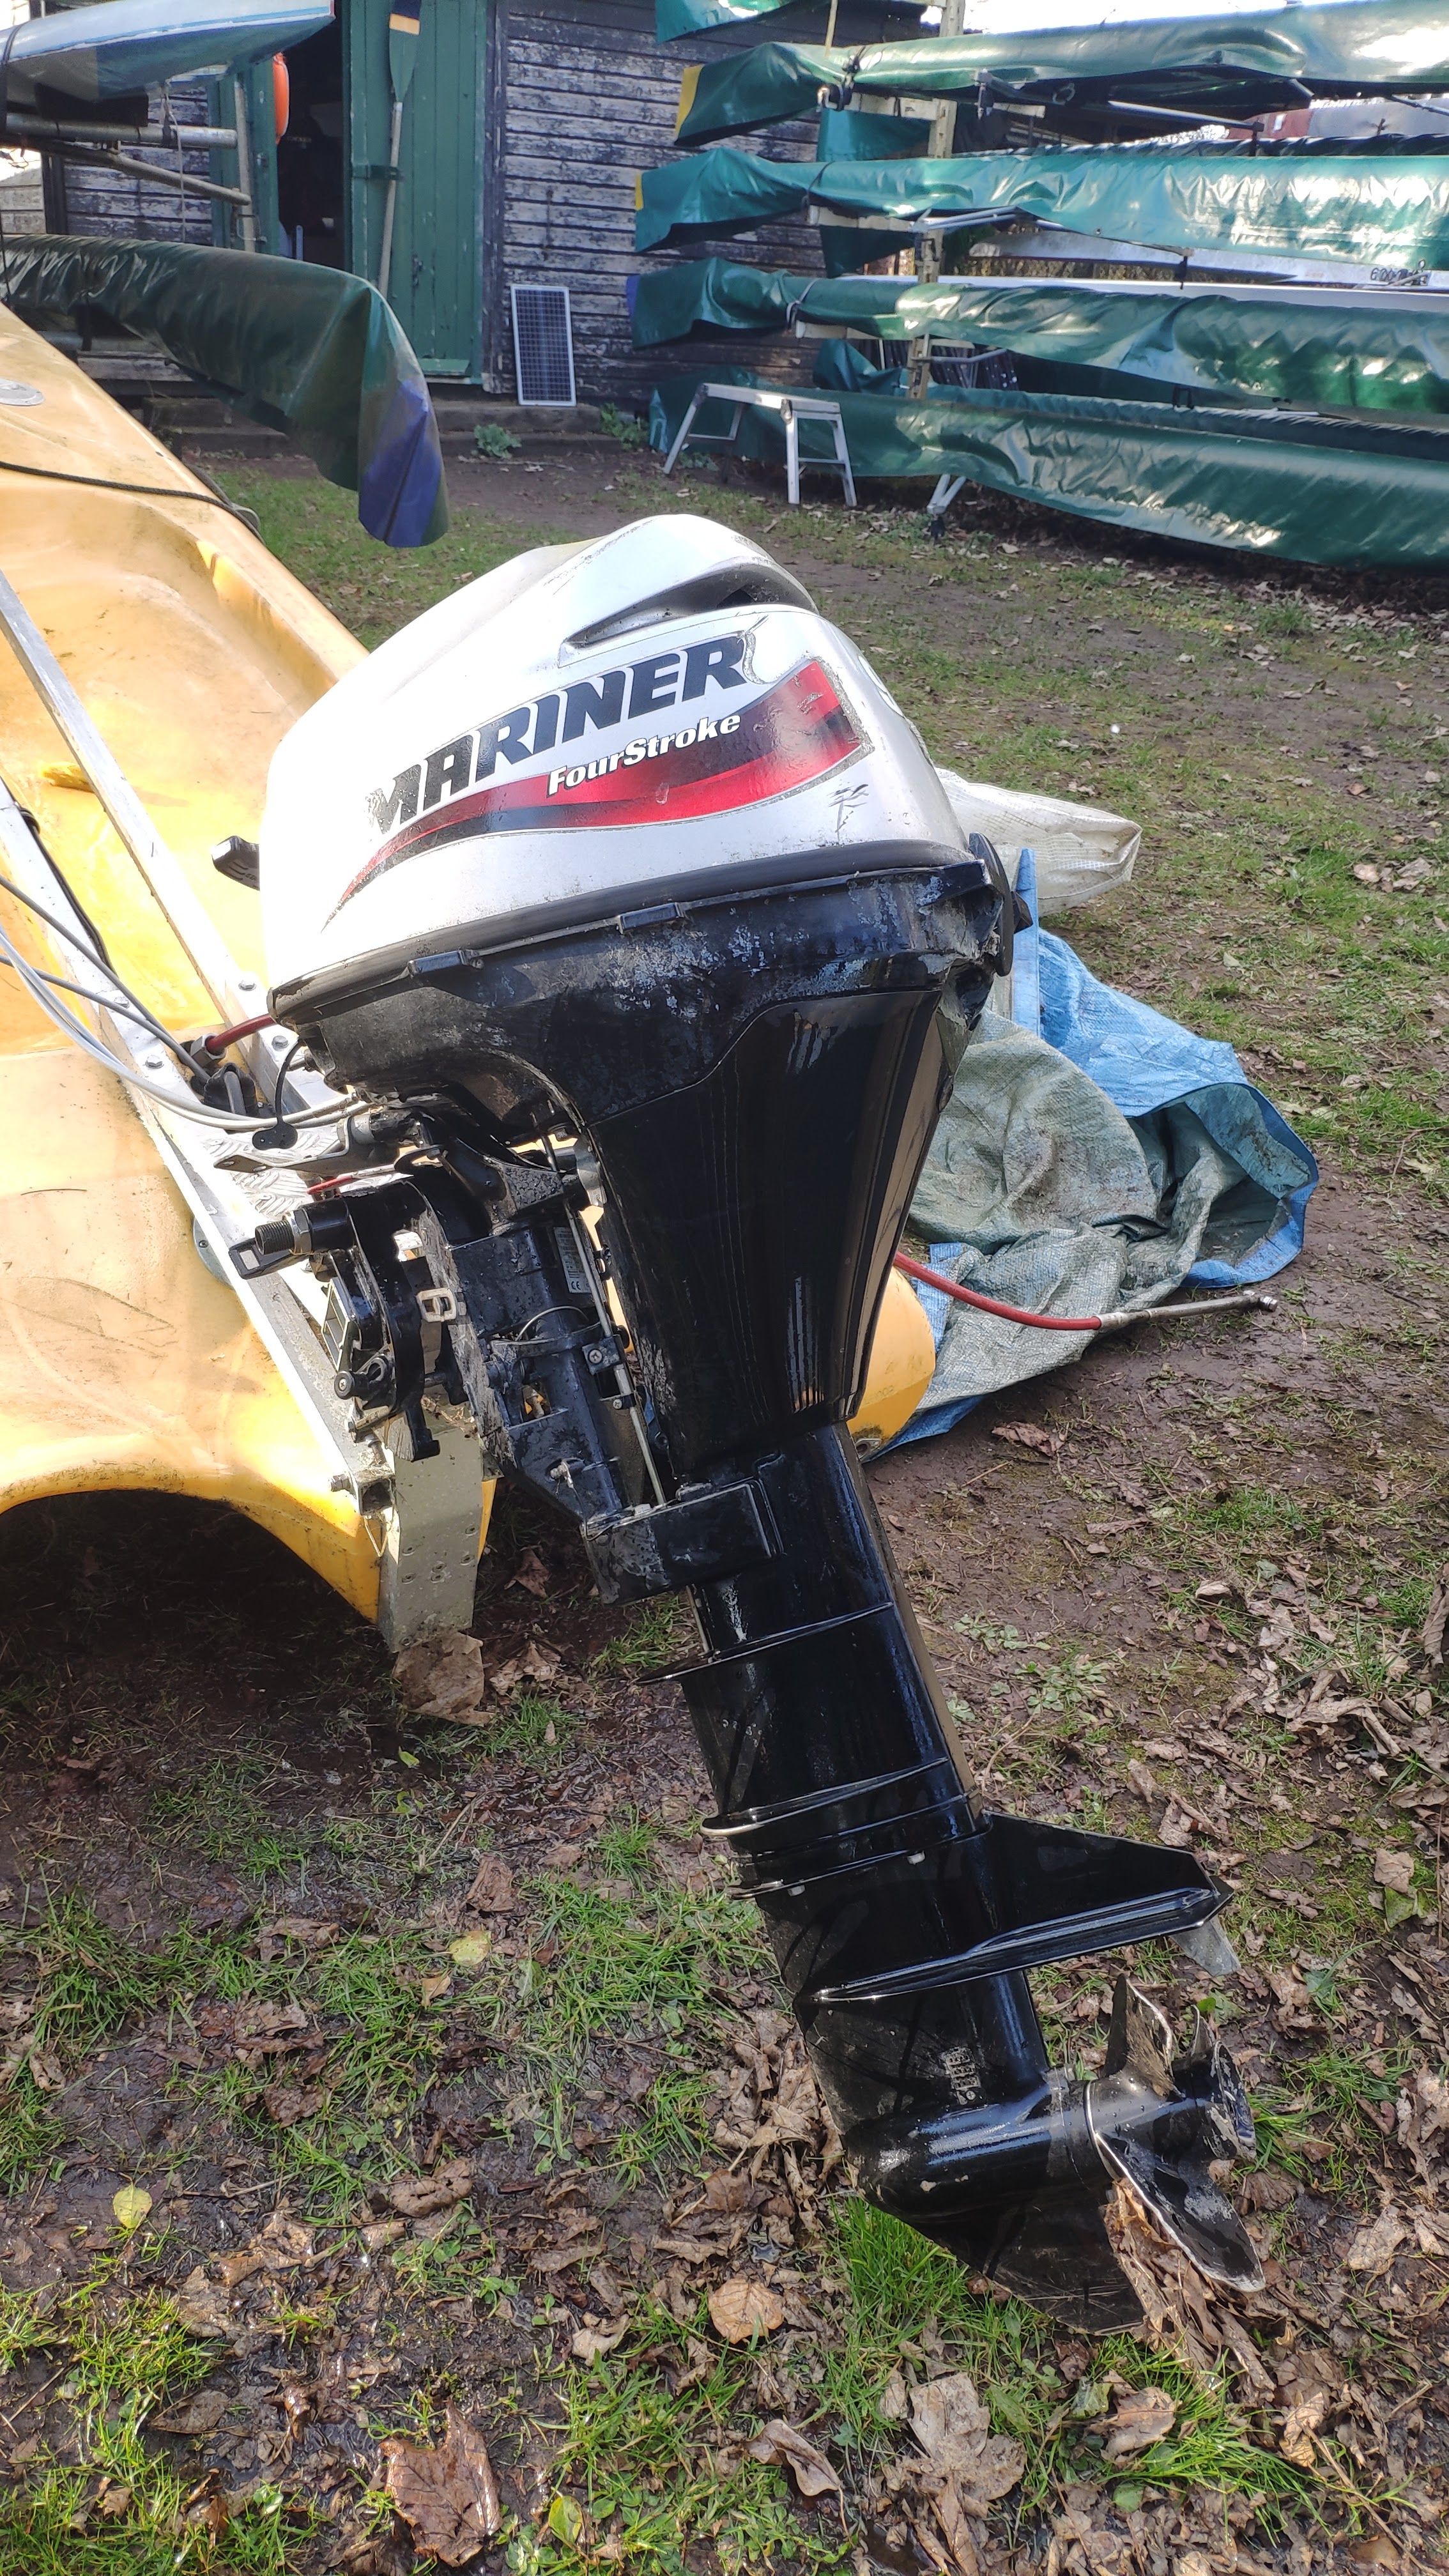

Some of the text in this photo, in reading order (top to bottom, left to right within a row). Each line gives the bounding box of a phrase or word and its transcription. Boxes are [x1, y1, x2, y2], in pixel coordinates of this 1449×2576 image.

[365, 635, 748, 834] MARINER
[547, 712, 741, 798] FourStroke
[571, 1280, 581, 1291] CE
